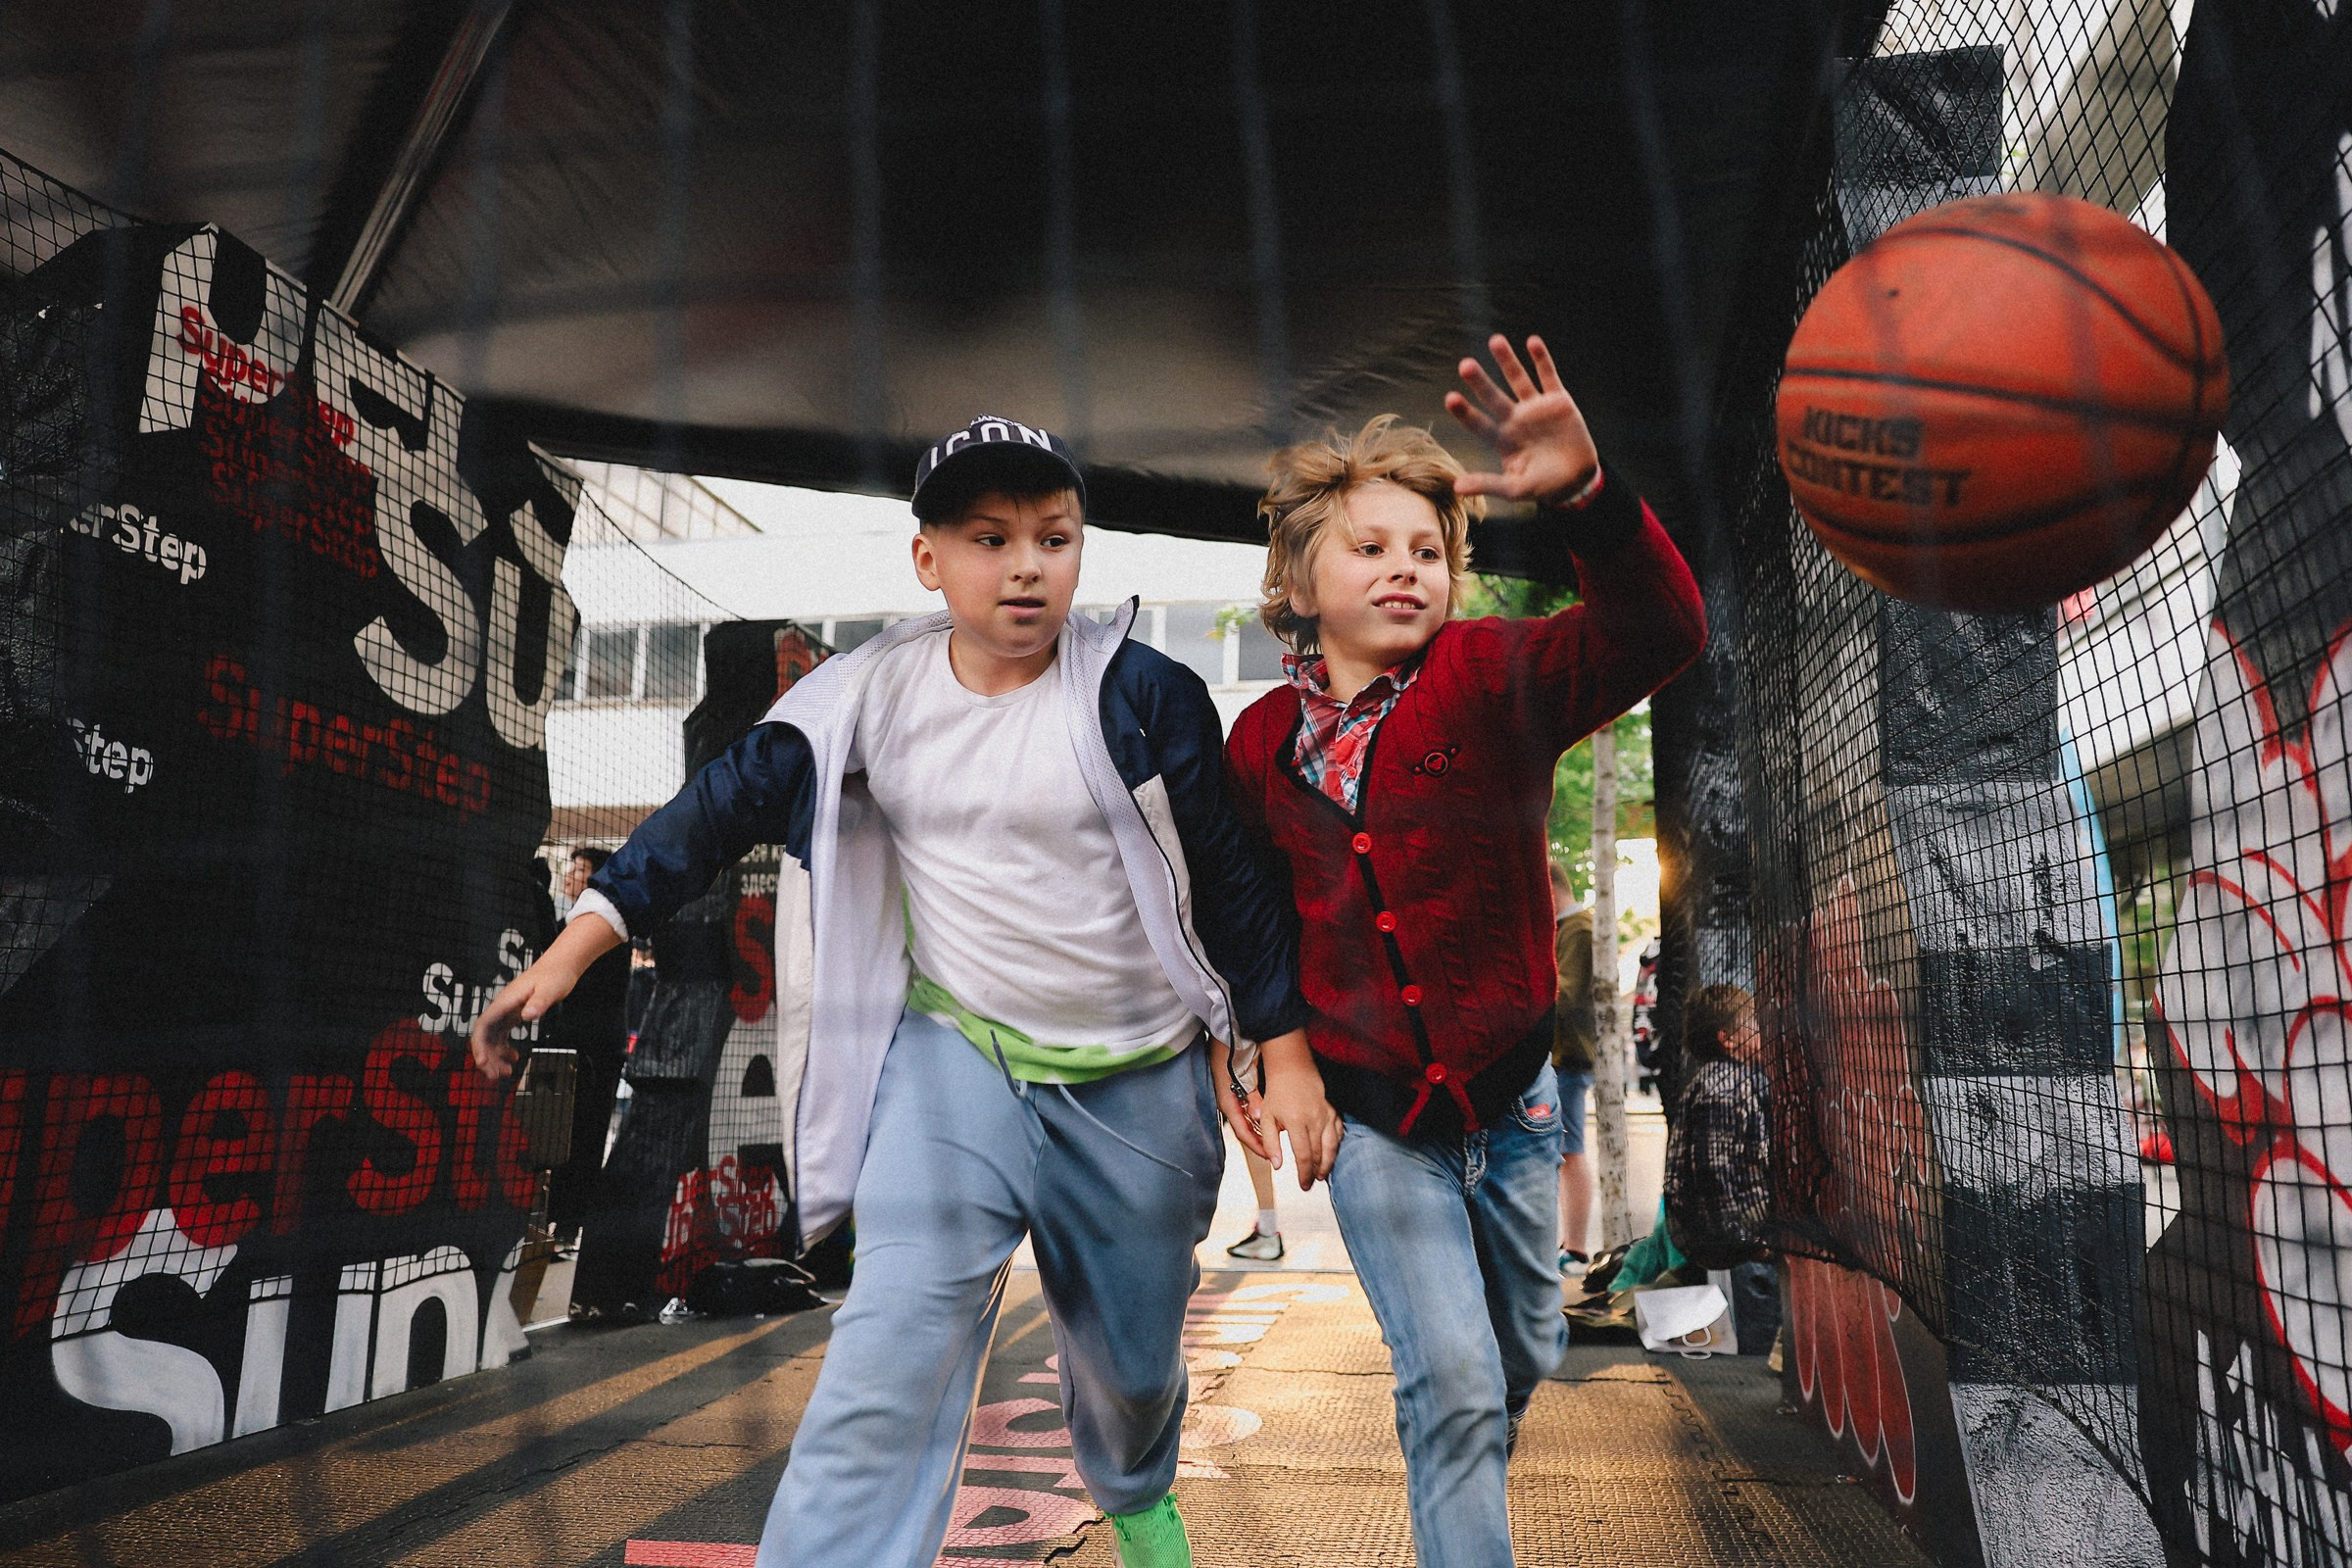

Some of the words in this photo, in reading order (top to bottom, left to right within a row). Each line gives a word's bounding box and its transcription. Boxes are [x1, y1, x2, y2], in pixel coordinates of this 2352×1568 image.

[1803, 407, 1924, 460] KICKS
[1787, 438, 1970, 508] CONTEST
[196, 653, 492, 823] SuperStep
